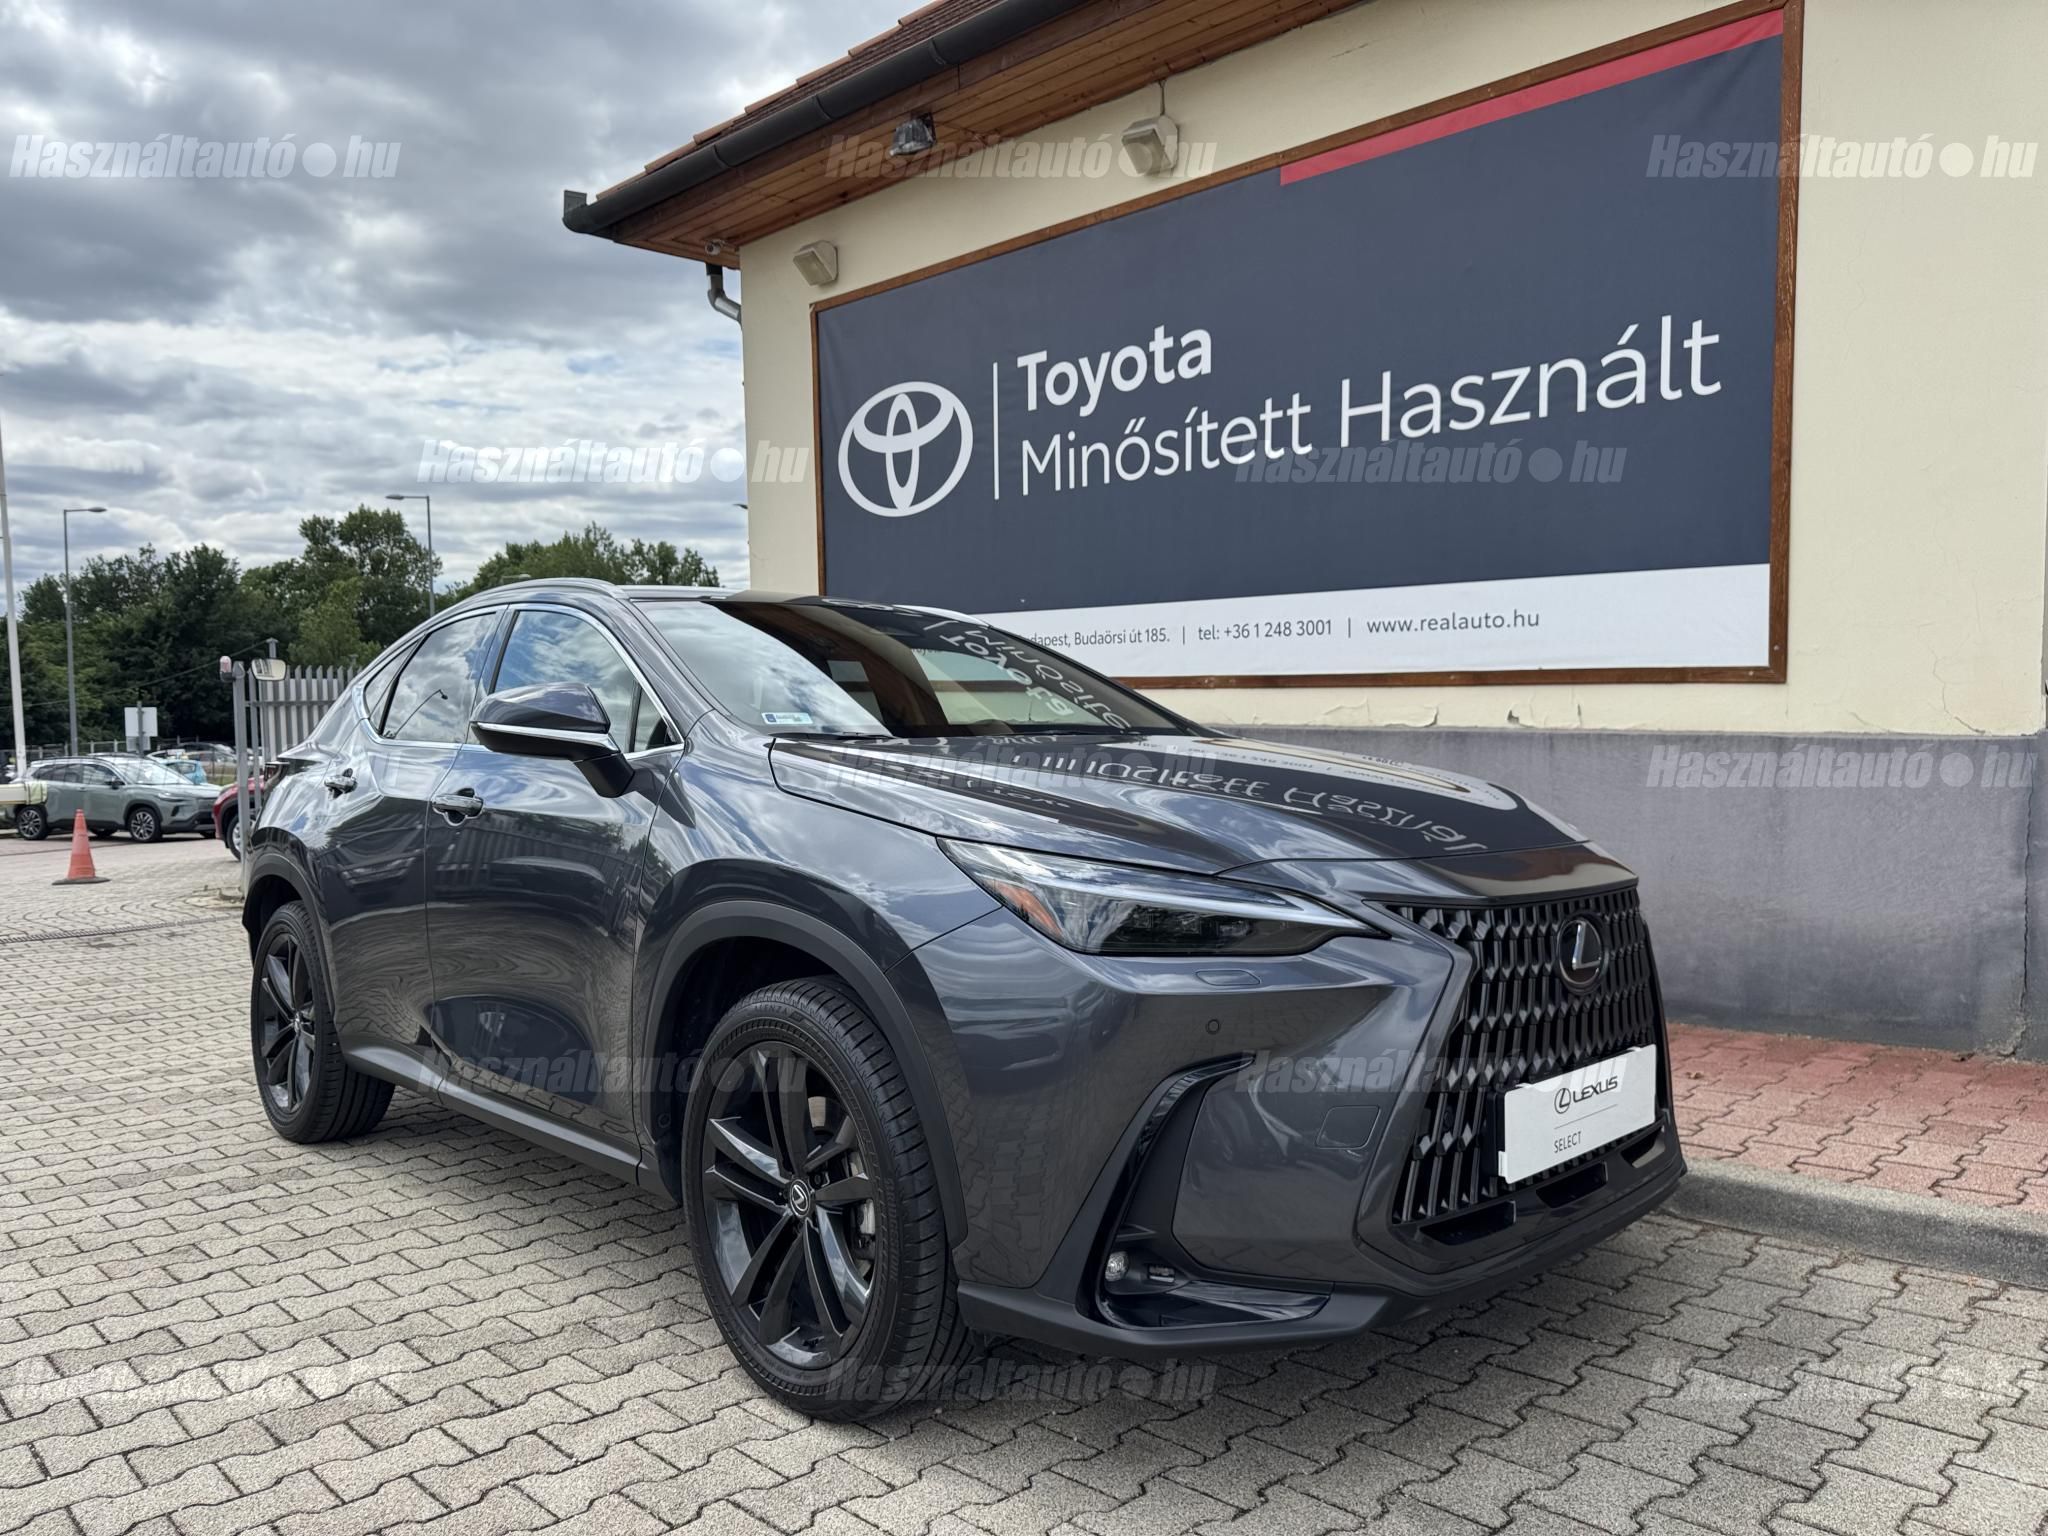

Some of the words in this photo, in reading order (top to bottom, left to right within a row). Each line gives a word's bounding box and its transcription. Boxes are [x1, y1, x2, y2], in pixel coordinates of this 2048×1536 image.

[1017, 325, 1211, 417] Toyota
[1022, 392, 1312, 496] Minősített
[1340, 314, 1722, 448] Használt
[1074, 630, 1126, 646] Budaörsi
[1128, 629, 1142, 644] út
[1145, 628, 1170, 643] 185.
[1198, 624, 1220, 641] tel:
[1223, 623, 1250, 639] +36
[1253, 622, 1260, 638] 1
[1264, 621, 1292, 638] 248
[1296, 619, 1332, 637] 3001
[1366, 609, 1540, 633] www.realauto.hu
[1572, 1075, 1619, 1103] LEXUS
[1553, 1130, 1582, 1154] SELECT
